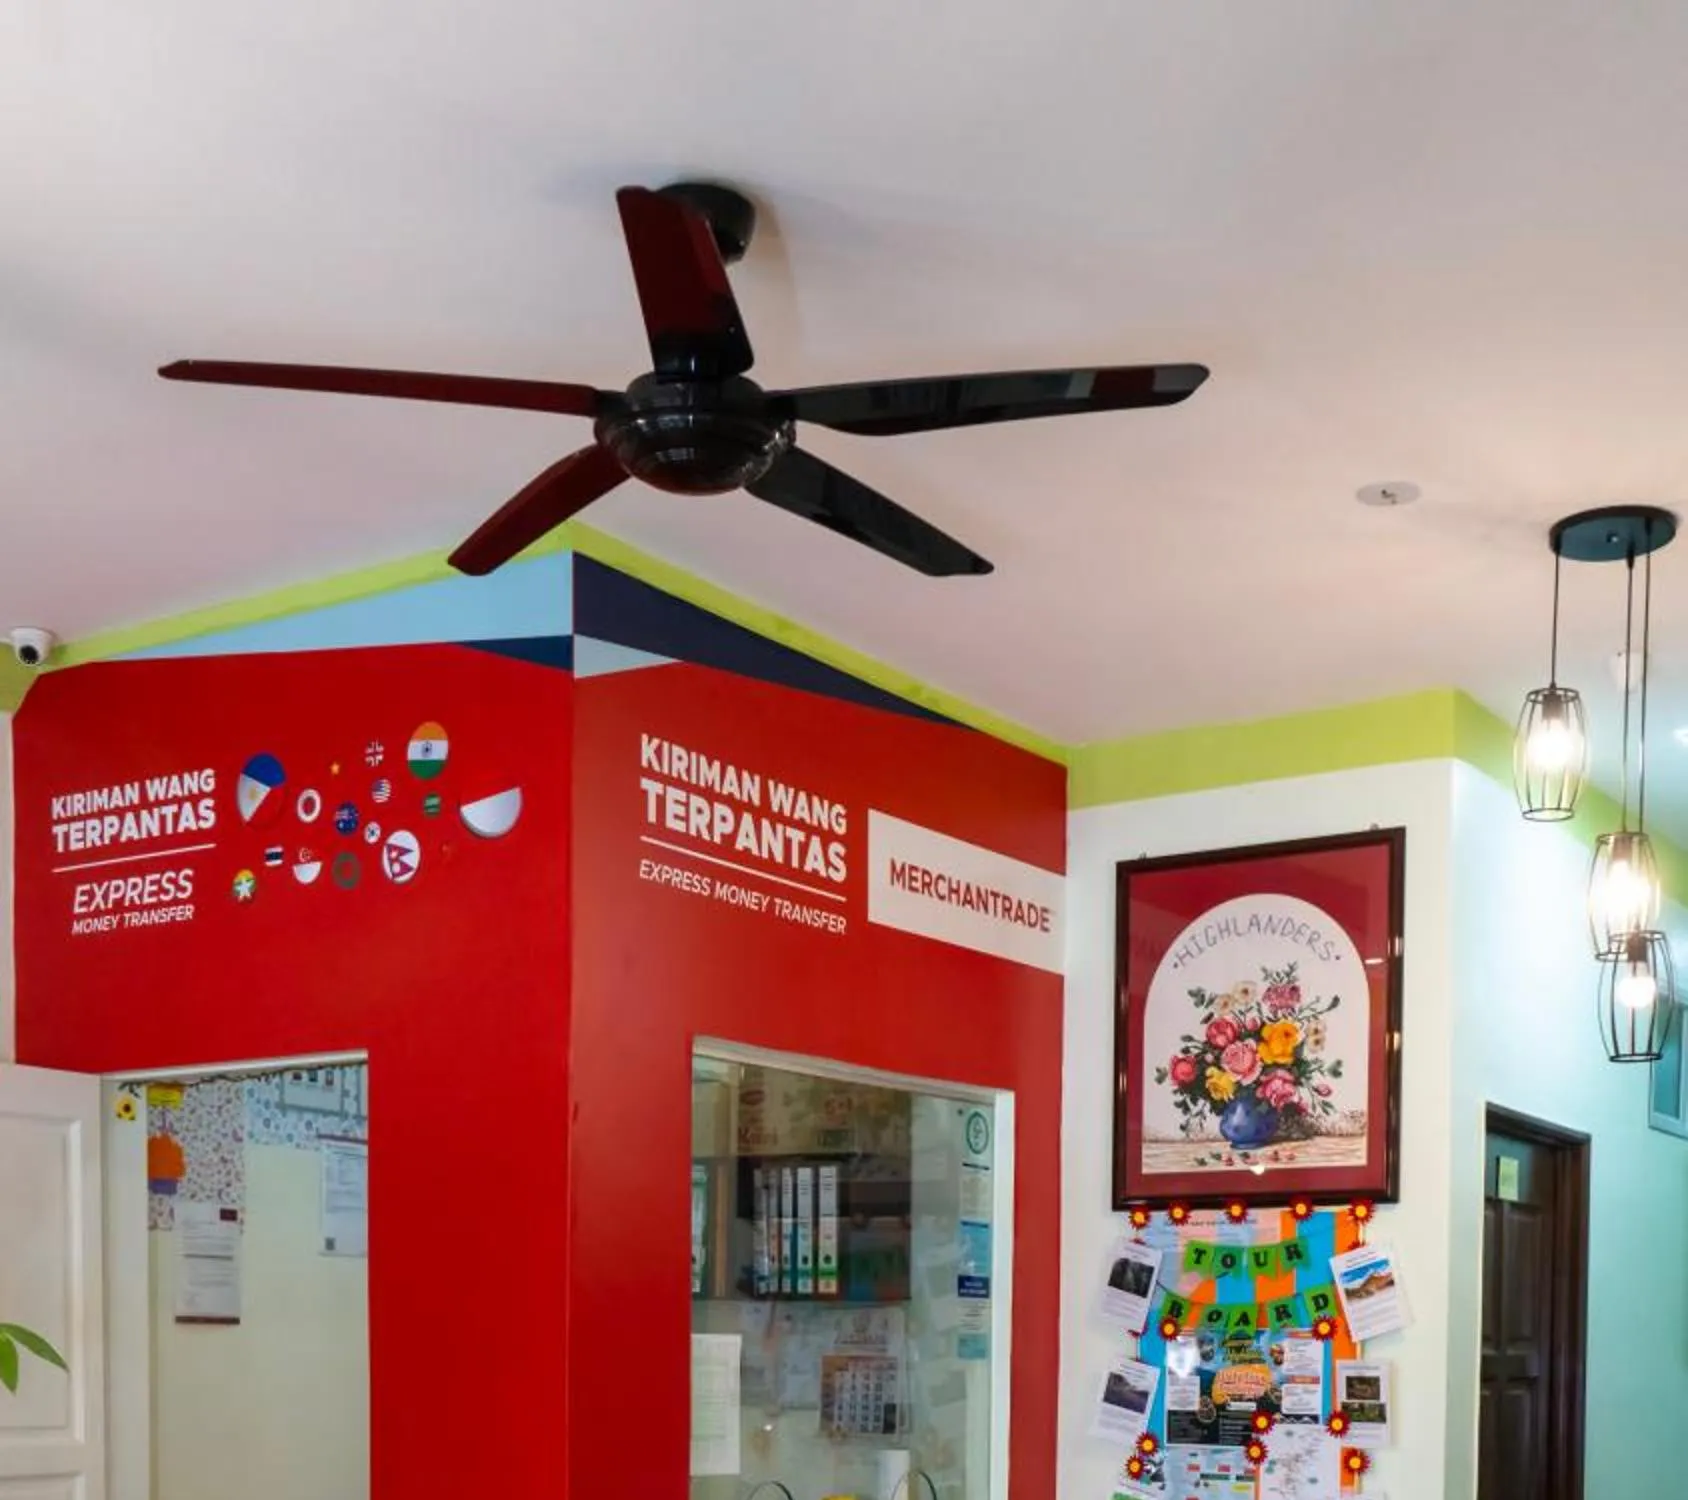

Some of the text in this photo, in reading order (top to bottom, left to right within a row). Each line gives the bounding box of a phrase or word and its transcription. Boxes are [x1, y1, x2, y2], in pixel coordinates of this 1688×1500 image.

[52, 768, 216, 818] KIRIMAN WANG
[640, 733, 848, 835] KIRIMAN WANG
[52, 799, 215, 853] TERPANTAS
[640, 779, 848, 884] TERPANTAS
[71, 904, 194, 935] MONEY TRANSFER
[73, 868, 194, 914] EXPRESS
[639, 859, 847, 936] EXPRESS MONEY TRANSFER
[889, 858, 1052, 933] MERCHANTRADE
